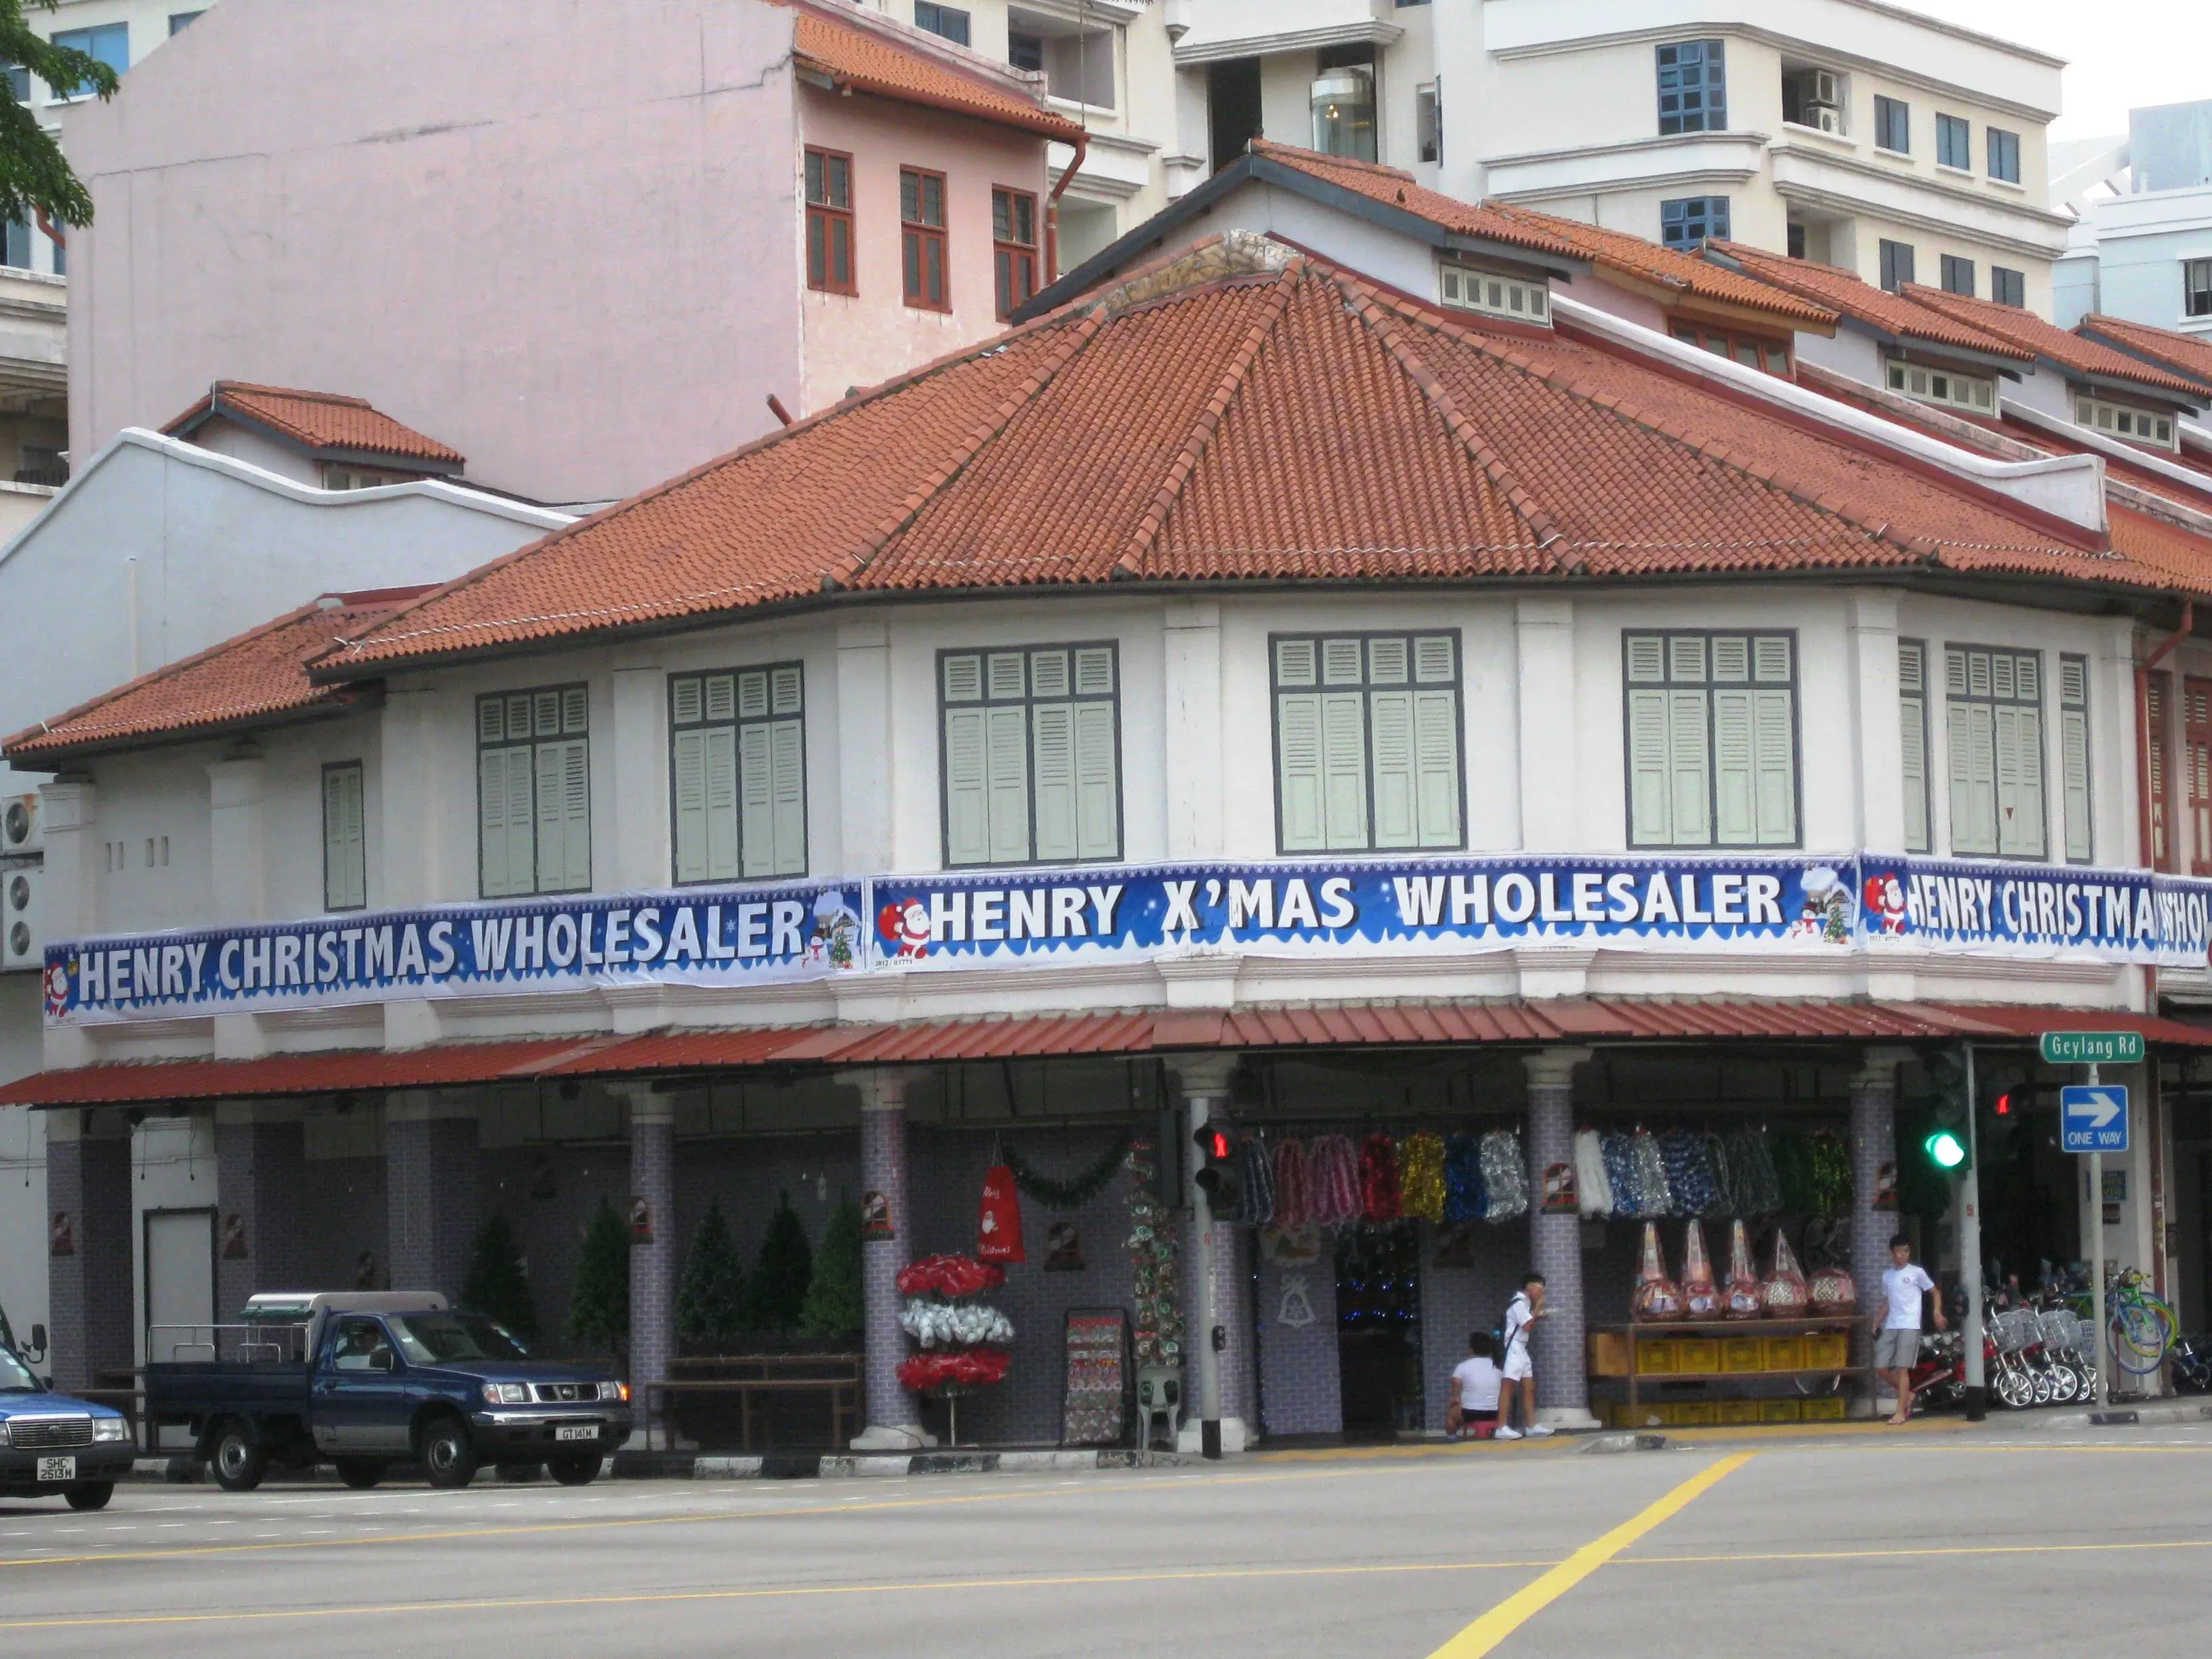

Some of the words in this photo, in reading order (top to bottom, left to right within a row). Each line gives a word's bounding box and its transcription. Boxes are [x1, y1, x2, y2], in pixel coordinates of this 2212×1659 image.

[930, 886, 1124, 941] HENRY
[1163, 878, 1356, 930] X'MAS
[1393, 872, 1782, 926] WHOLESALER
[1907, 875, 1992, 930] HENRY
[2002, 880, 2158, 938] CHRISTMA
[79, 943, 206, 1002] HENRY
[219, 922, 455, 989] CHRISTMAS
[471, 900, 805, 971] WHOLESALER
[2052, 1036, 2113, 1059] Geylang
[2118, 1036, 2136, 1054] Rd
[2068, 1132, 2093, 1145] ONE
[2099, 1132, 2122, 1145] WAY
[41, 1469, 72, 1479] 2513M
[47, 1458, 67, 1469] SHC
